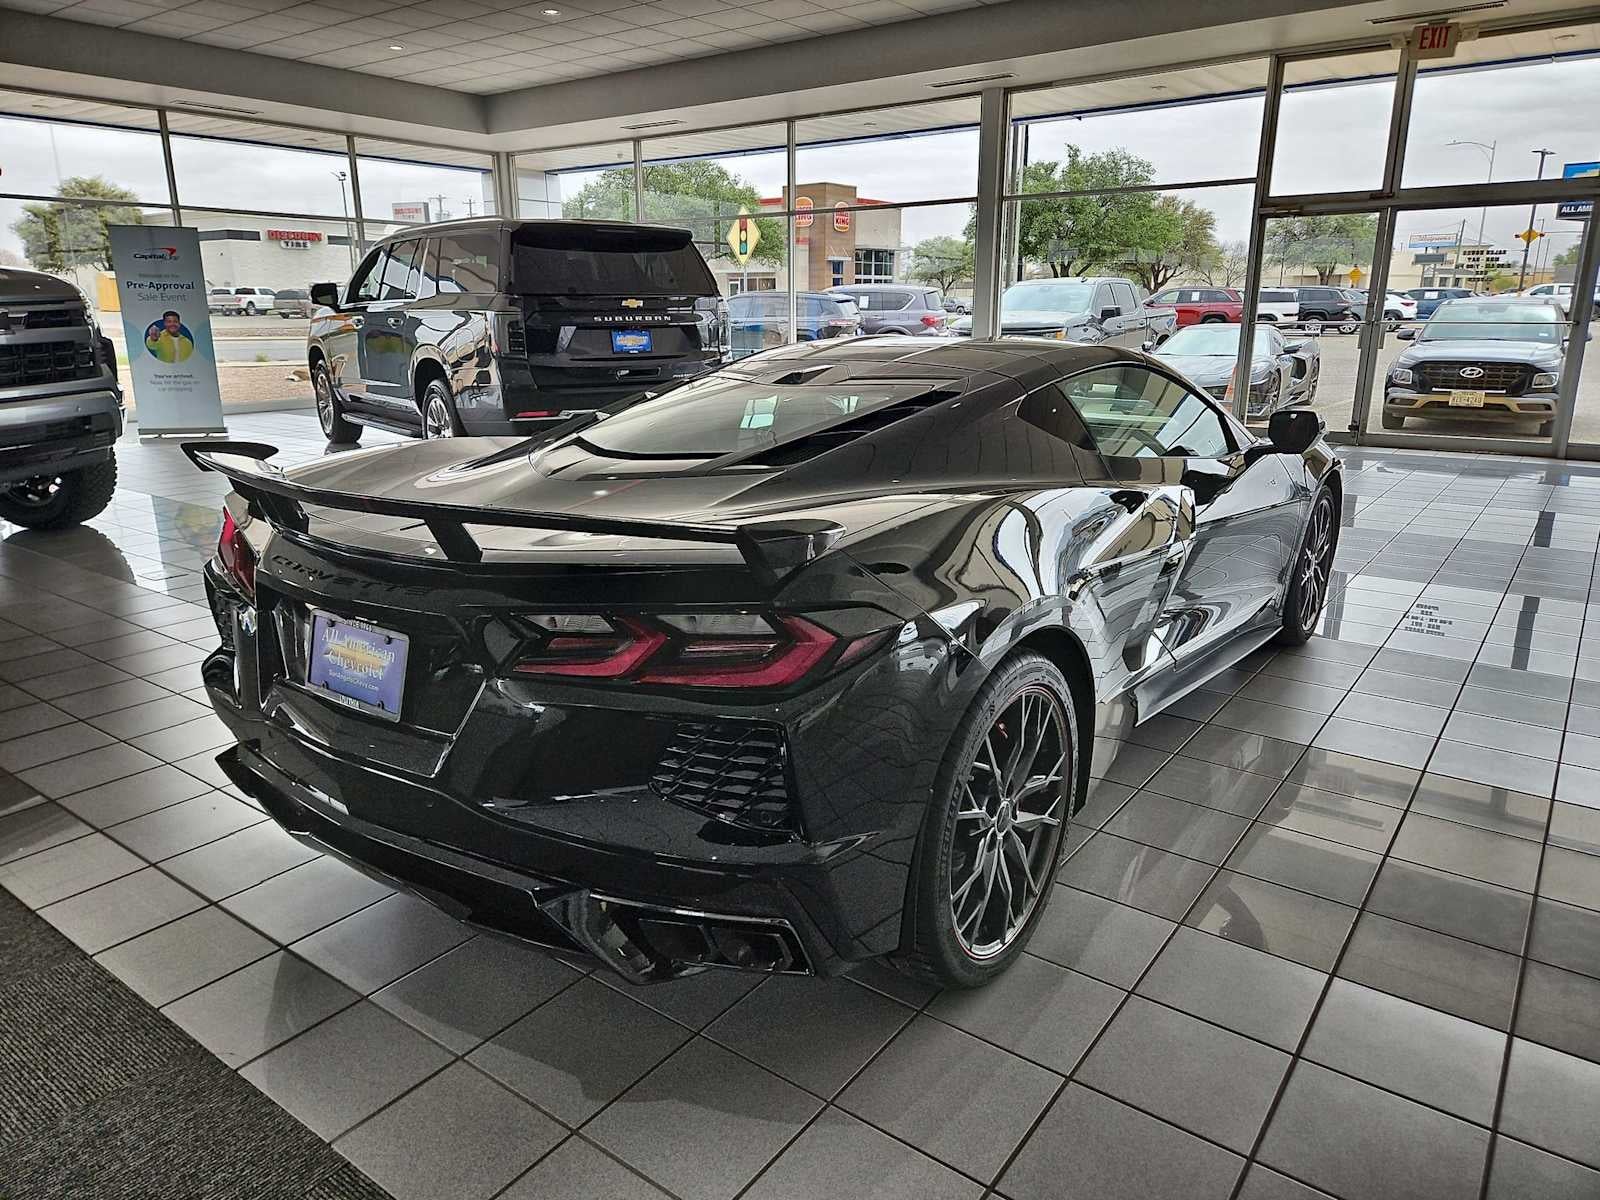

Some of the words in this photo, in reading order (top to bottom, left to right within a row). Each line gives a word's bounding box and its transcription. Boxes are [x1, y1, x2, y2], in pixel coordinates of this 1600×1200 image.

[1418, 26, 1452, 49] EXIT
[267, 230, 323, 241] DISCOUNT
[126, 281, 195, 291] Pre-Approval
[138, 292, 157, 302] Sale
[160, 293, 187, 302] Event
[272, 555, 430, 596] CORVETTE
[321, 628, 339, 642] All
[344, 633, 395, 663] American
[328, 649, 385, 680] Chevrolet
